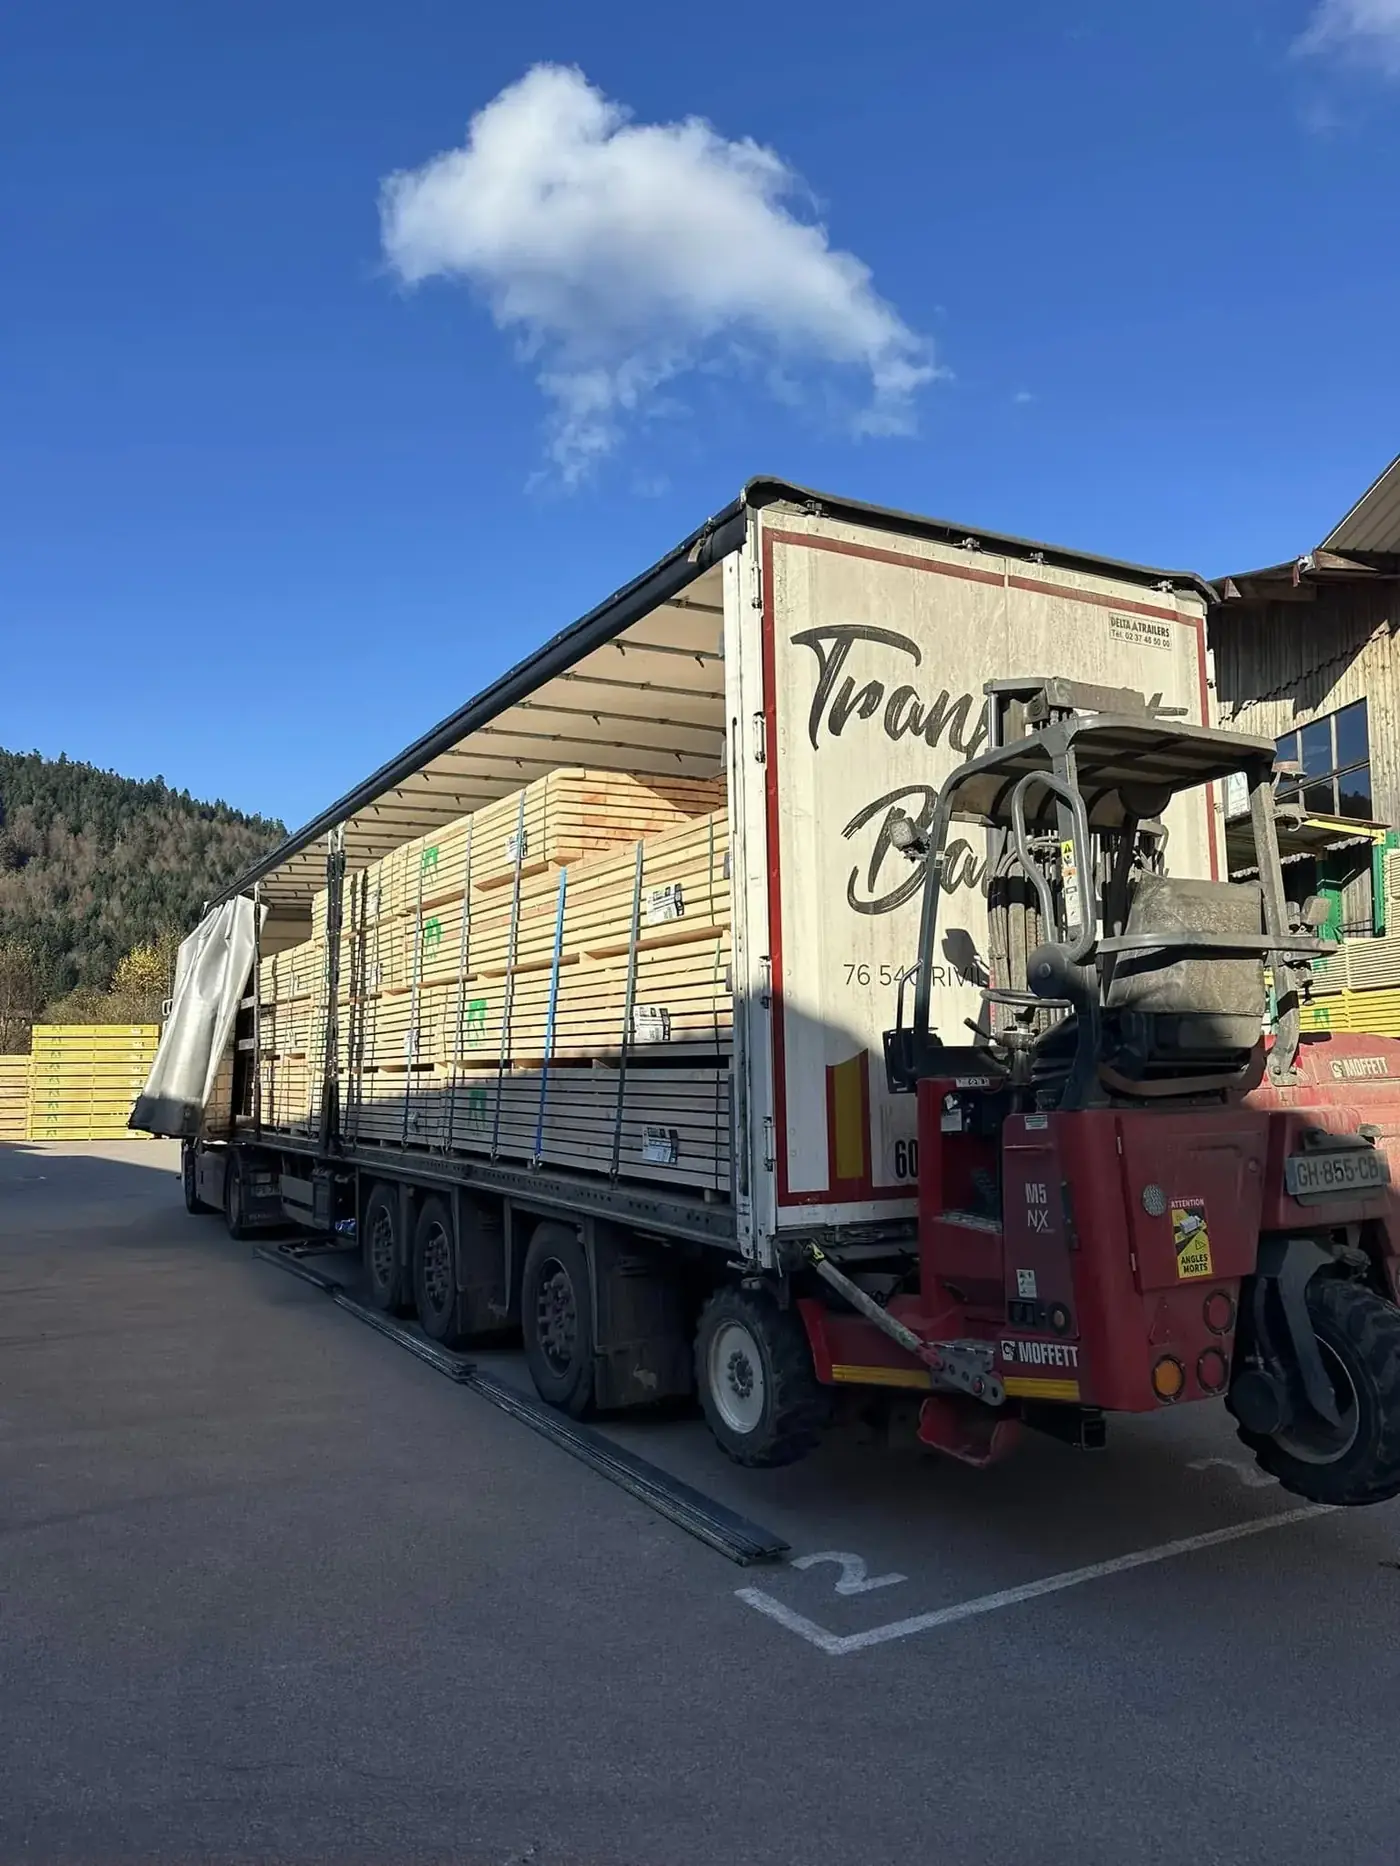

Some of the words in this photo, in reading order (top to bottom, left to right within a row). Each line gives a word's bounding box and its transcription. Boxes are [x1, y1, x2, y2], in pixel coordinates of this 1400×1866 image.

[1110, 616, 1131, 630] DELTA
[843, 963, 871, 986] 76
[1345, 1056, 1388, 1078] MOFFETT
[894, 1138, 919, 1179] 60
[1025, 1182, 1048, 1204] M5
[1171, 1198, 1205, 1209] ATTENTION
[1027, 1208, 1049, 1233] NX
[1181, 1253, 1208, 1265] ANGLES
[1183, 1263, 1208, 1274] MORTS
[1018, 1341, 1078, 1368] MOFFETT
[789, 1551, 908, 1595] 2
